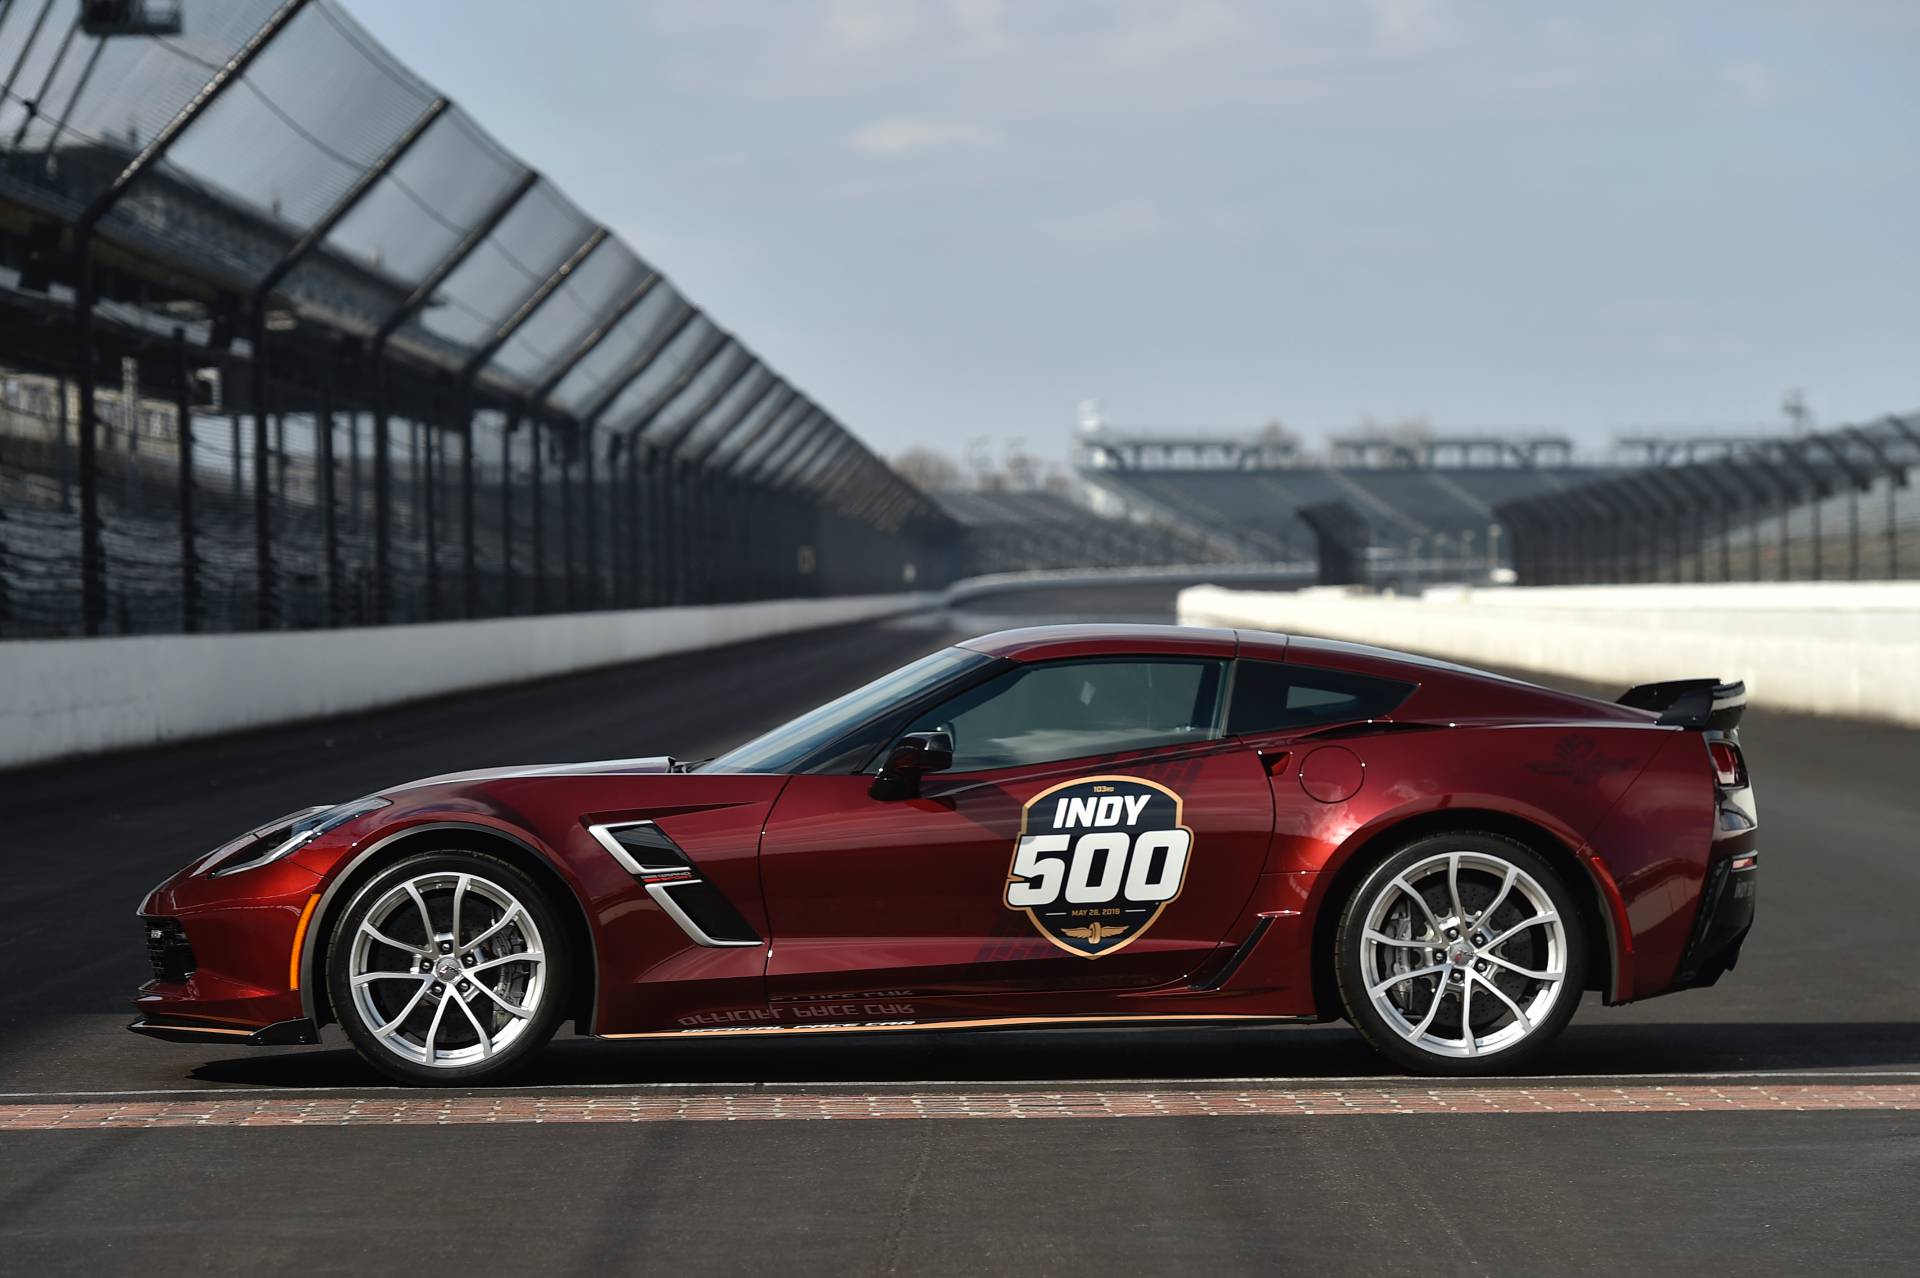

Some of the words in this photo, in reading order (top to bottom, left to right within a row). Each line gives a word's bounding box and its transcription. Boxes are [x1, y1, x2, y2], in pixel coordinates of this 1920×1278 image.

[1053, 795, 1151, 829] INDY
[1008, 829, 1190, 906] 500
[1101, 907, 1121, 916] 2019
